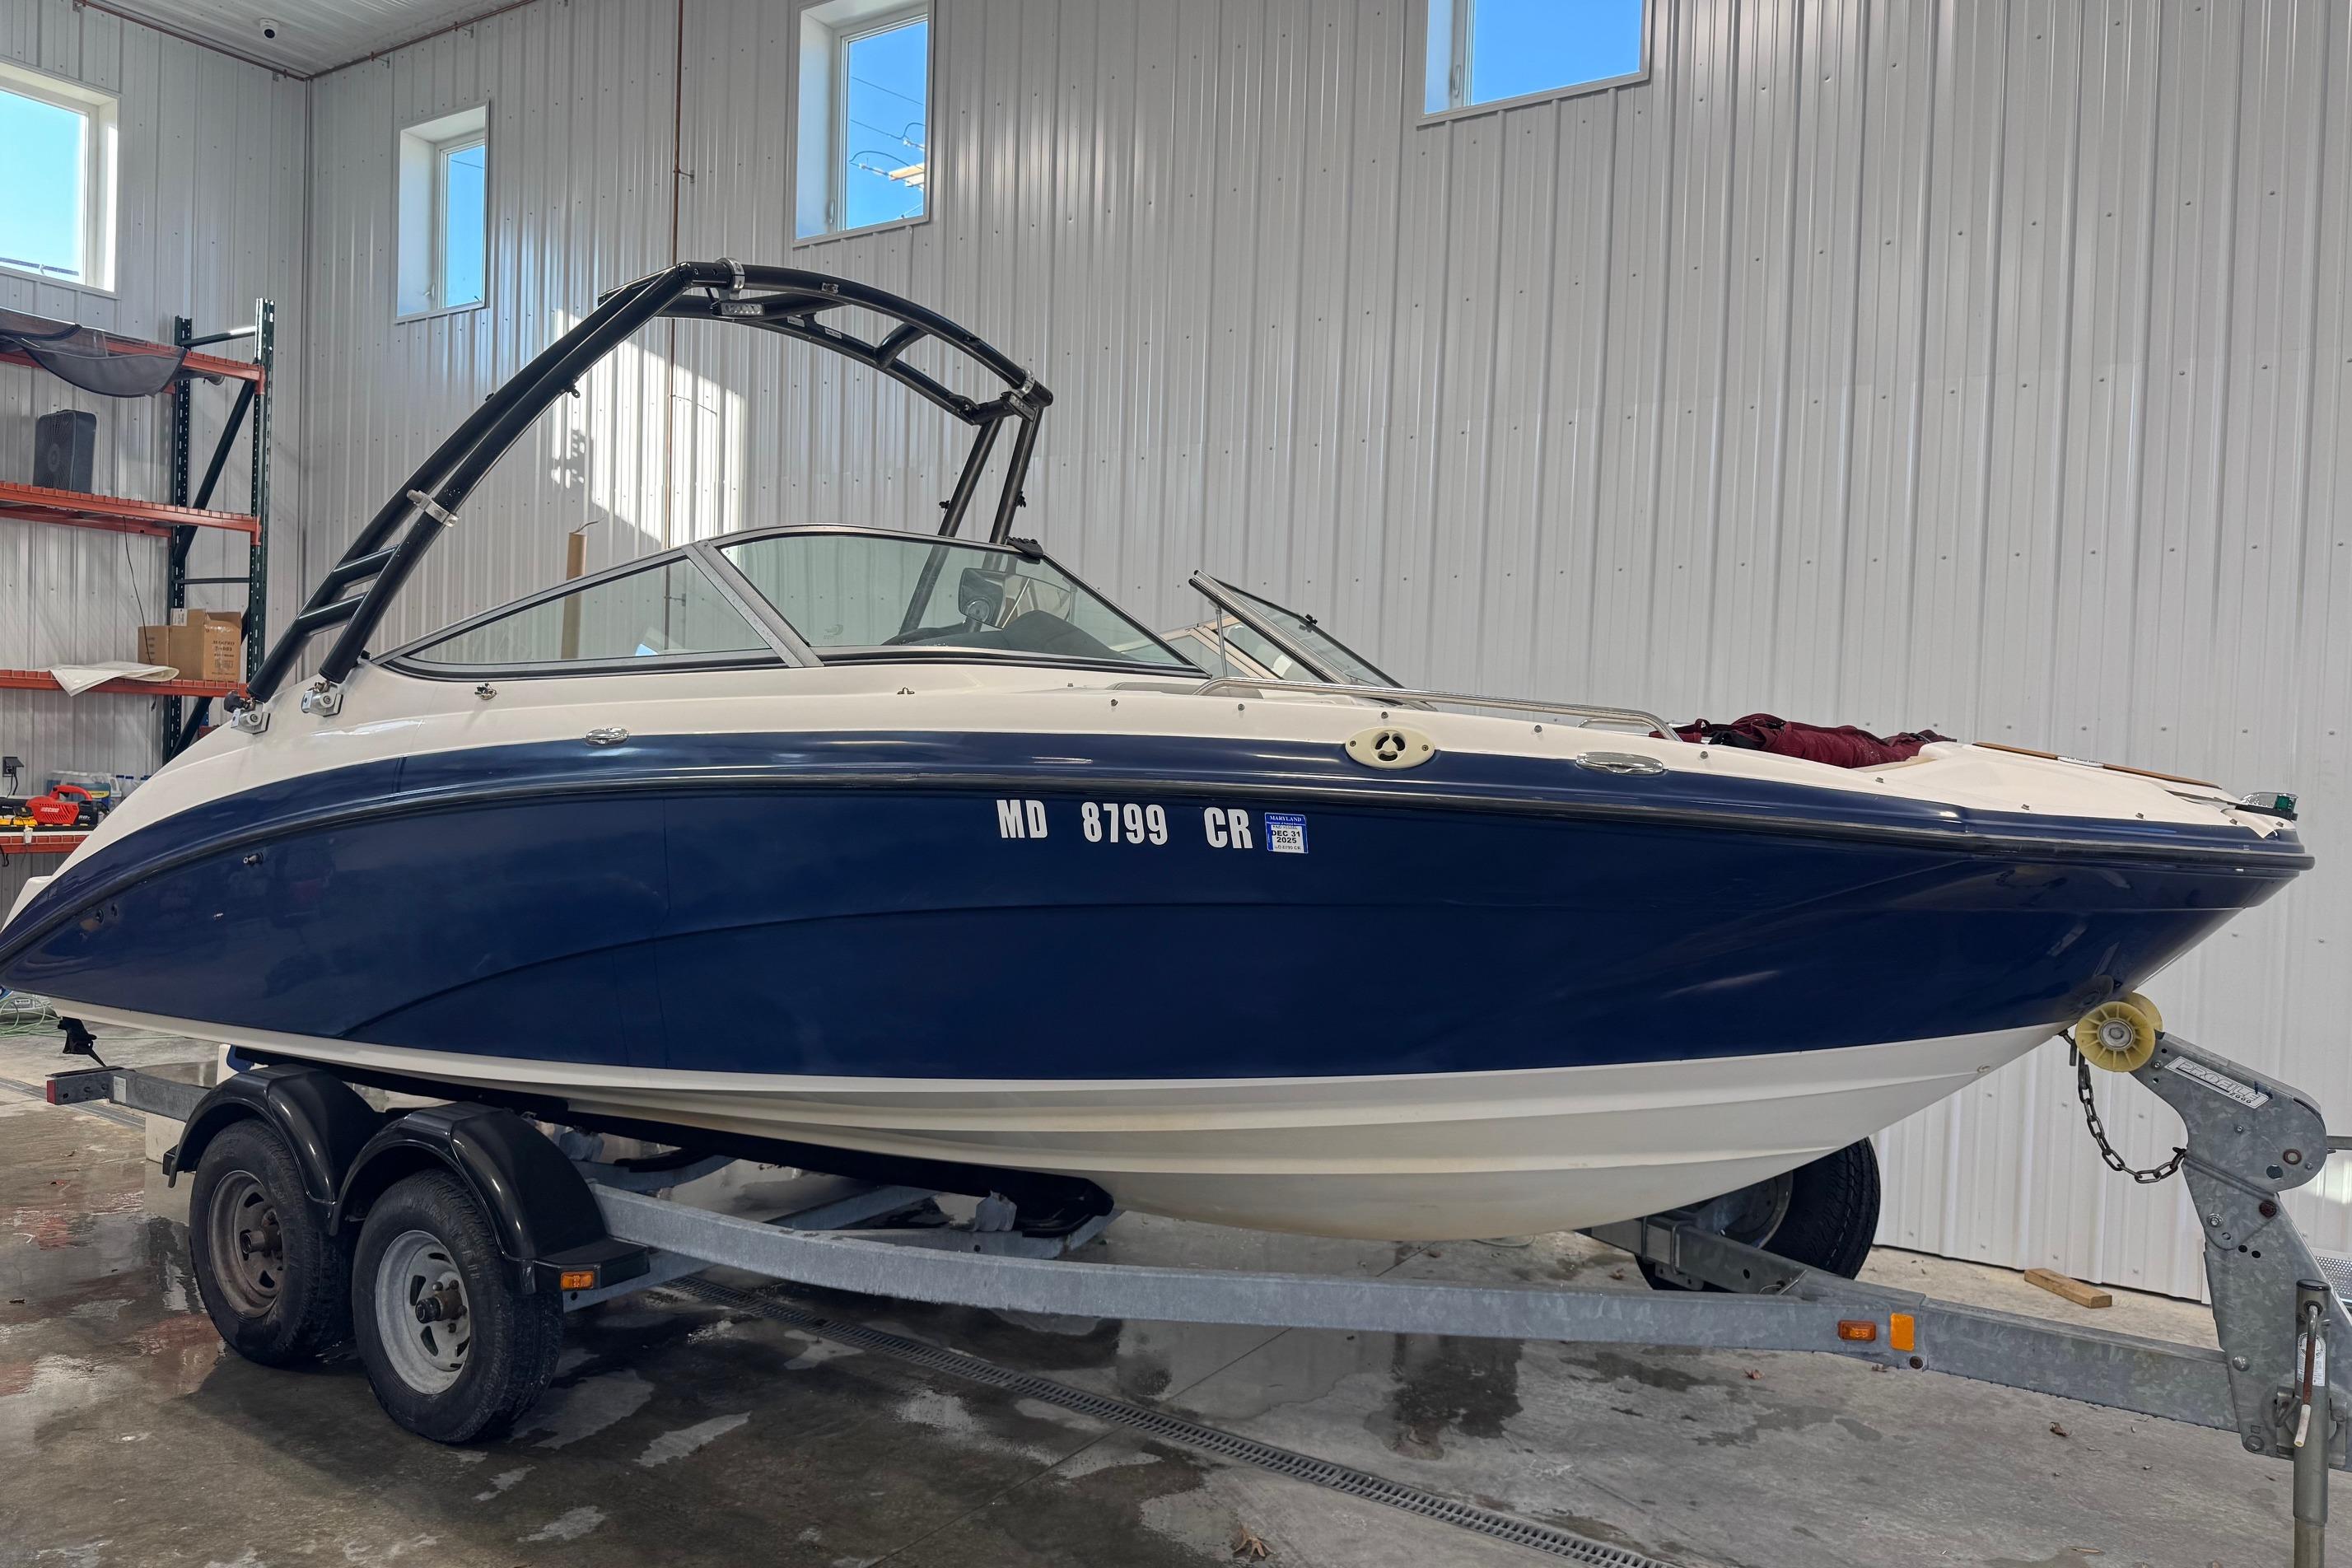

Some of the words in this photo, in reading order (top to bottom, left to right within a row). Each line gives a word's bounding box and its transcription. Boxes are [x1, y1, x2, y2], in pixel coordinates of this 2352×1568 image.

[996, 799, 1048, 838] MD
[1080, 801, 1169, 846] 8799
[1203, 806, 1253, 849] CR
[2177, 1061, 2261, 1102] PROFILE
[2229, 1092, 2252, 1104] 2000
